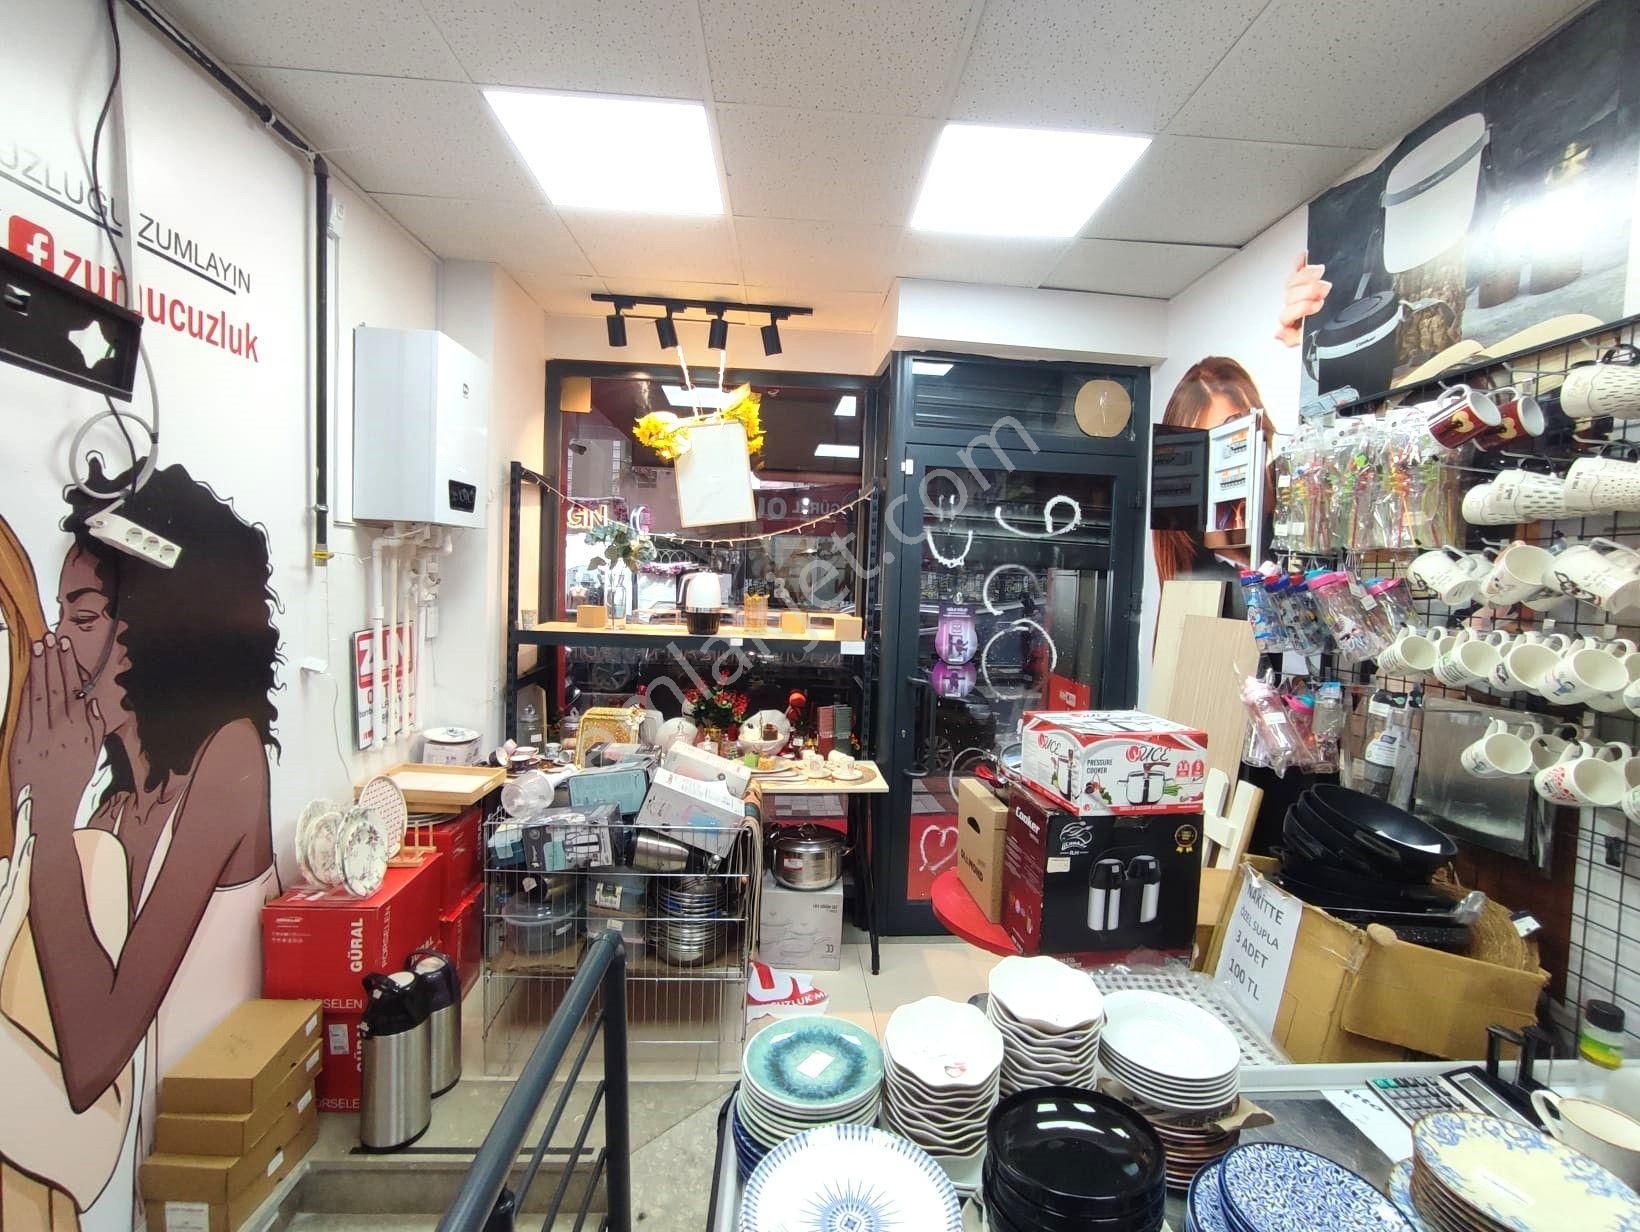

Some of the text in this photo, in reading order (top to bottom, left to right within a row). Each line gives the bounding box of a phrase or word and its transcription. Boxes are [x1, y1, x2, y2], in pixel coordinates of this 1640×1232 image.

[137, 213, 251, 294] ZUMLAYIN
[1087, 759, 1112, 767] PRESSURE
[1247, 883, 1284, 926] NAKİTTE
[347, 917, 363, 972] GÜRAL
[1235, 930, 1269, 969] 3 ADET
[1252, 922, 1279, 950] SUPLA
[1229, 958, 1260, 1001] 100 TL
